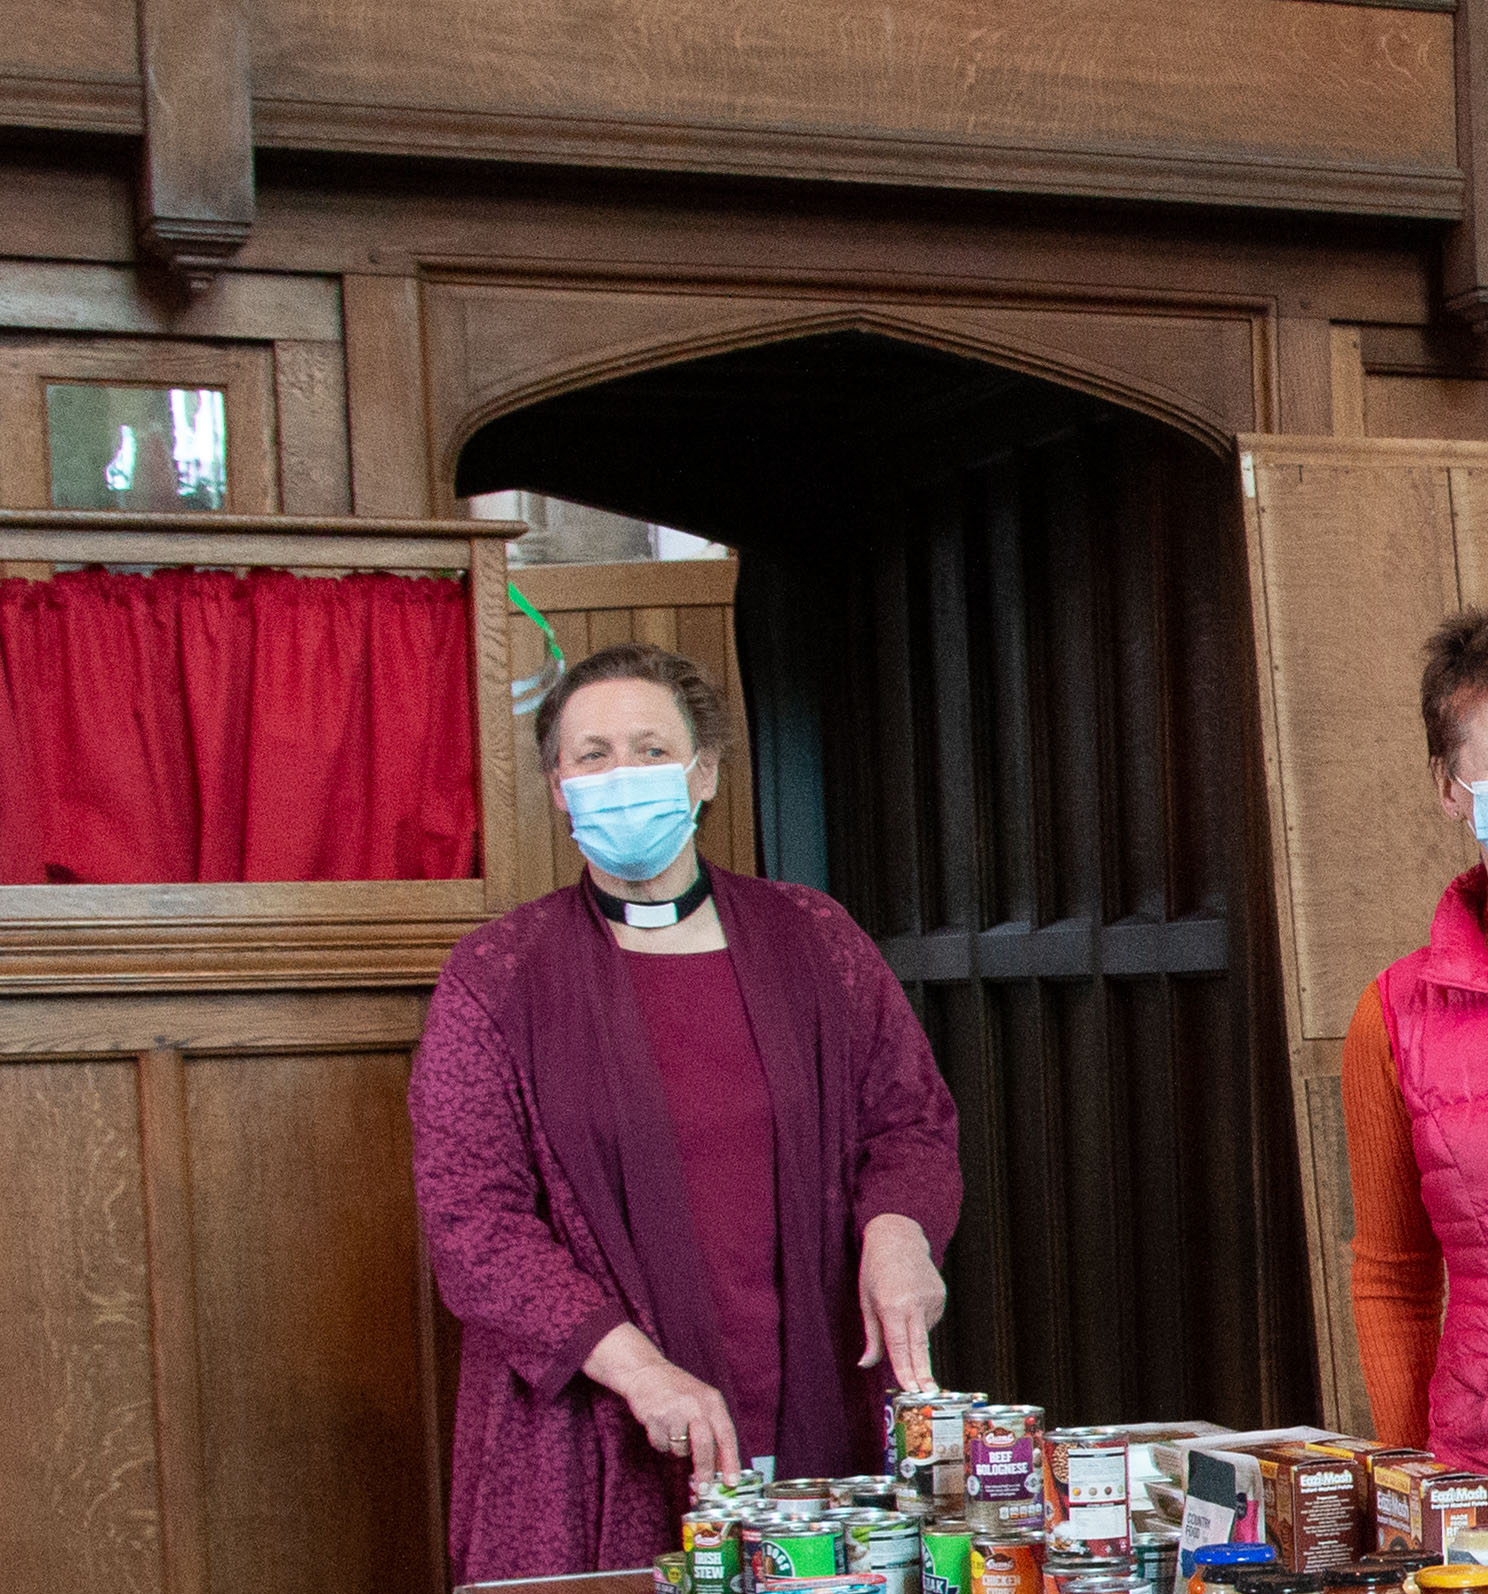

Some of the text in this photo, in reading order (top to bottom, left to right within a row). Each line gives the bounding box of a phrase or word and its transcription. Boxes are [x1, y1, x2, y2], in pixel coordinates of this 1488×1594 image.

[988, 1451, 1013, 1463] BEEF
[976, 1463, 1028, 1476] BOLOGNESE
[693, 1566, 724, 1579] STEW
